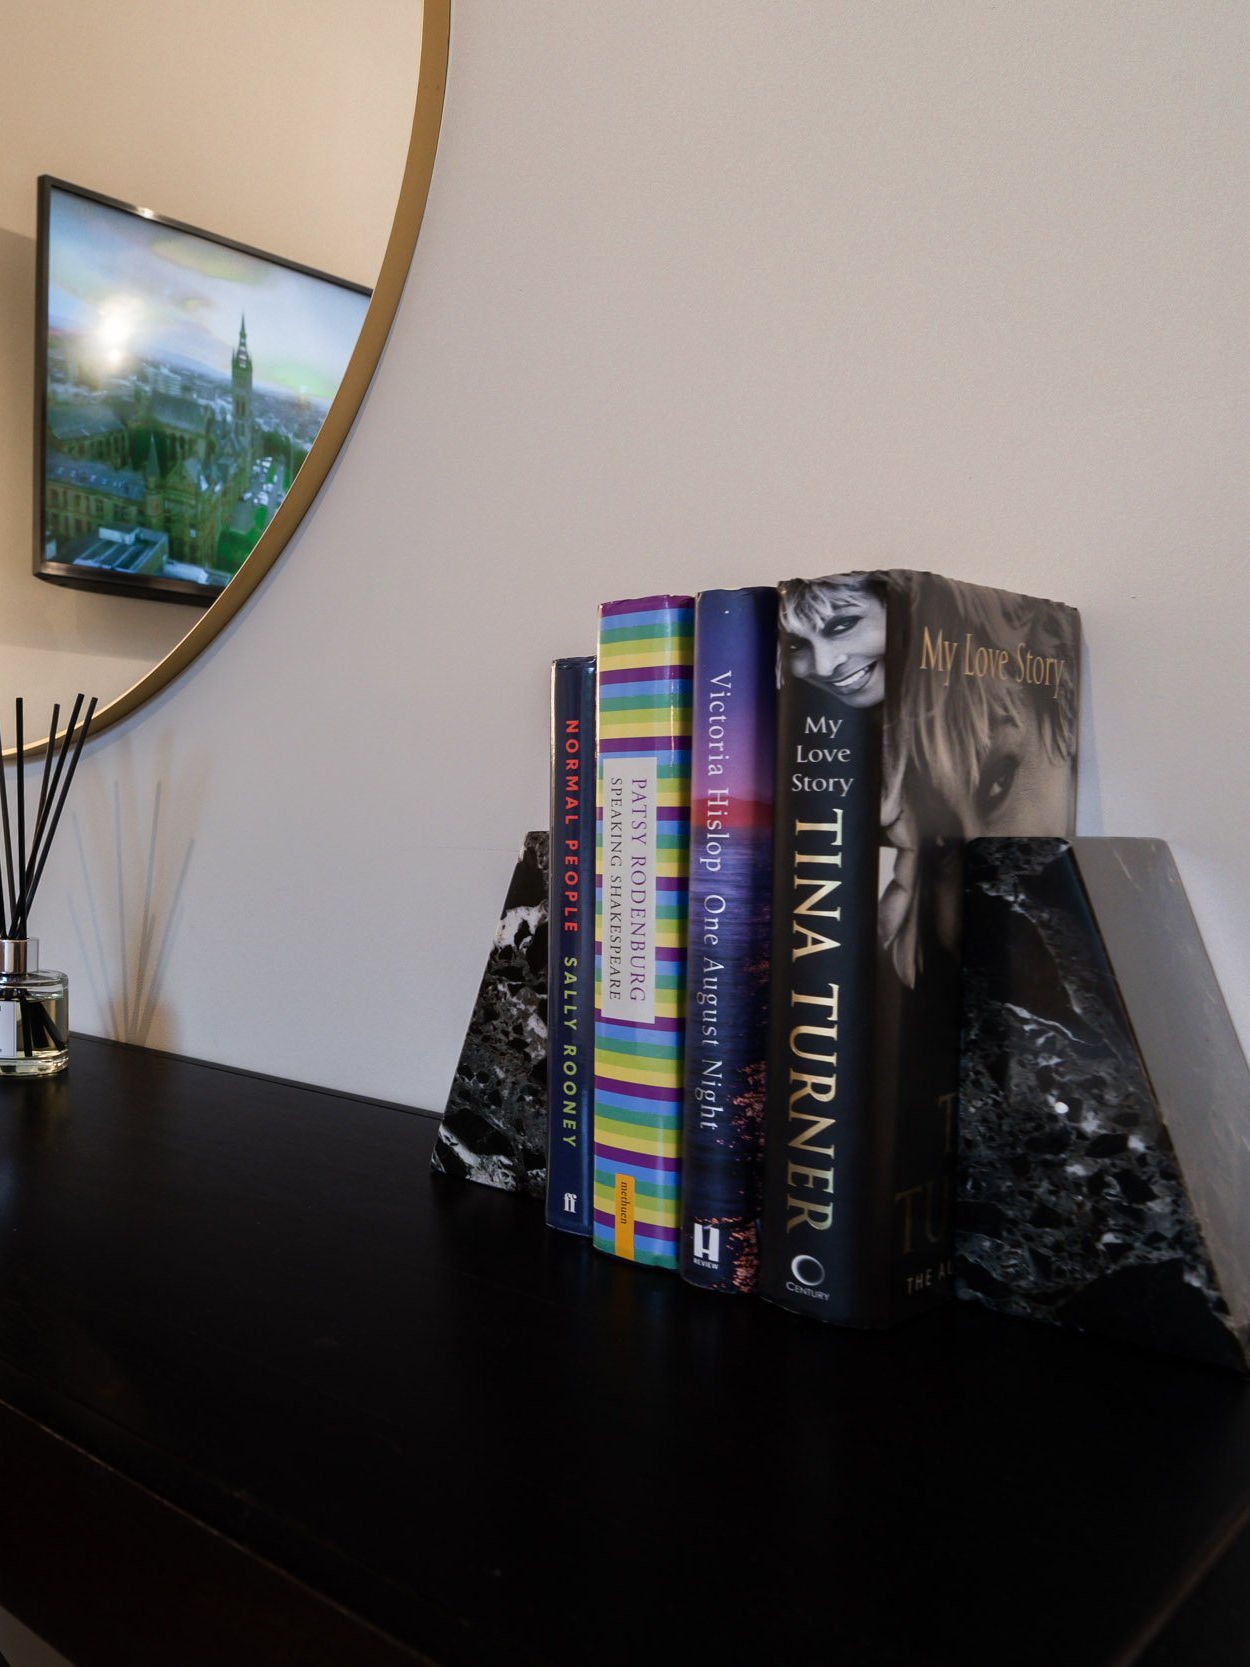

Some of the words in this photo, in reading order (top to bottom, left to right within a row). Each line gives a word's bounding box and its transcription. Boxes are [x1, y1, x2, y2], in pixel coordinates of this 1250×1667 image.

[918, 625, 958, 687] My
[963, 633, 1009, 681] Love
[1015, 641, 1066, 699] Story
[707, 670, 733, 776] Victoria
[795, 745, 852, 764] Love
[803, 715, 843, 739] My
[565, 719, 580, 825] NORMAL
[791, 773, 854, 798] Story
[610, 777, 623, 868] SPEAKING
[631, 778, 648, 845] PATSY
[700, 787, 731, 873] Hislop
[563, 839, 579, 933] PEOPLE
[703, 894, 727, 946] One
[792, 808, 844, 964] TINA
[609, 875, 623, 1001] SHAKESPEARE
[629, 855, 648, 1002] RODENBURG
[563, 956, 578, 1031] SALLY
[696, 957, 725, 1048] August
[562, 1044, 578, 1148] ROONEY
[694, 1059, 724, 1131] Night
[786, 983, 840, 1235] TURNER
[619, 1180, 629, 1226] methuen
[693, 1257, 719, 1271] REVIEW
[785, 1280, 831, 1302] CENTURY
[905, 1267, 933, 1297] THE
